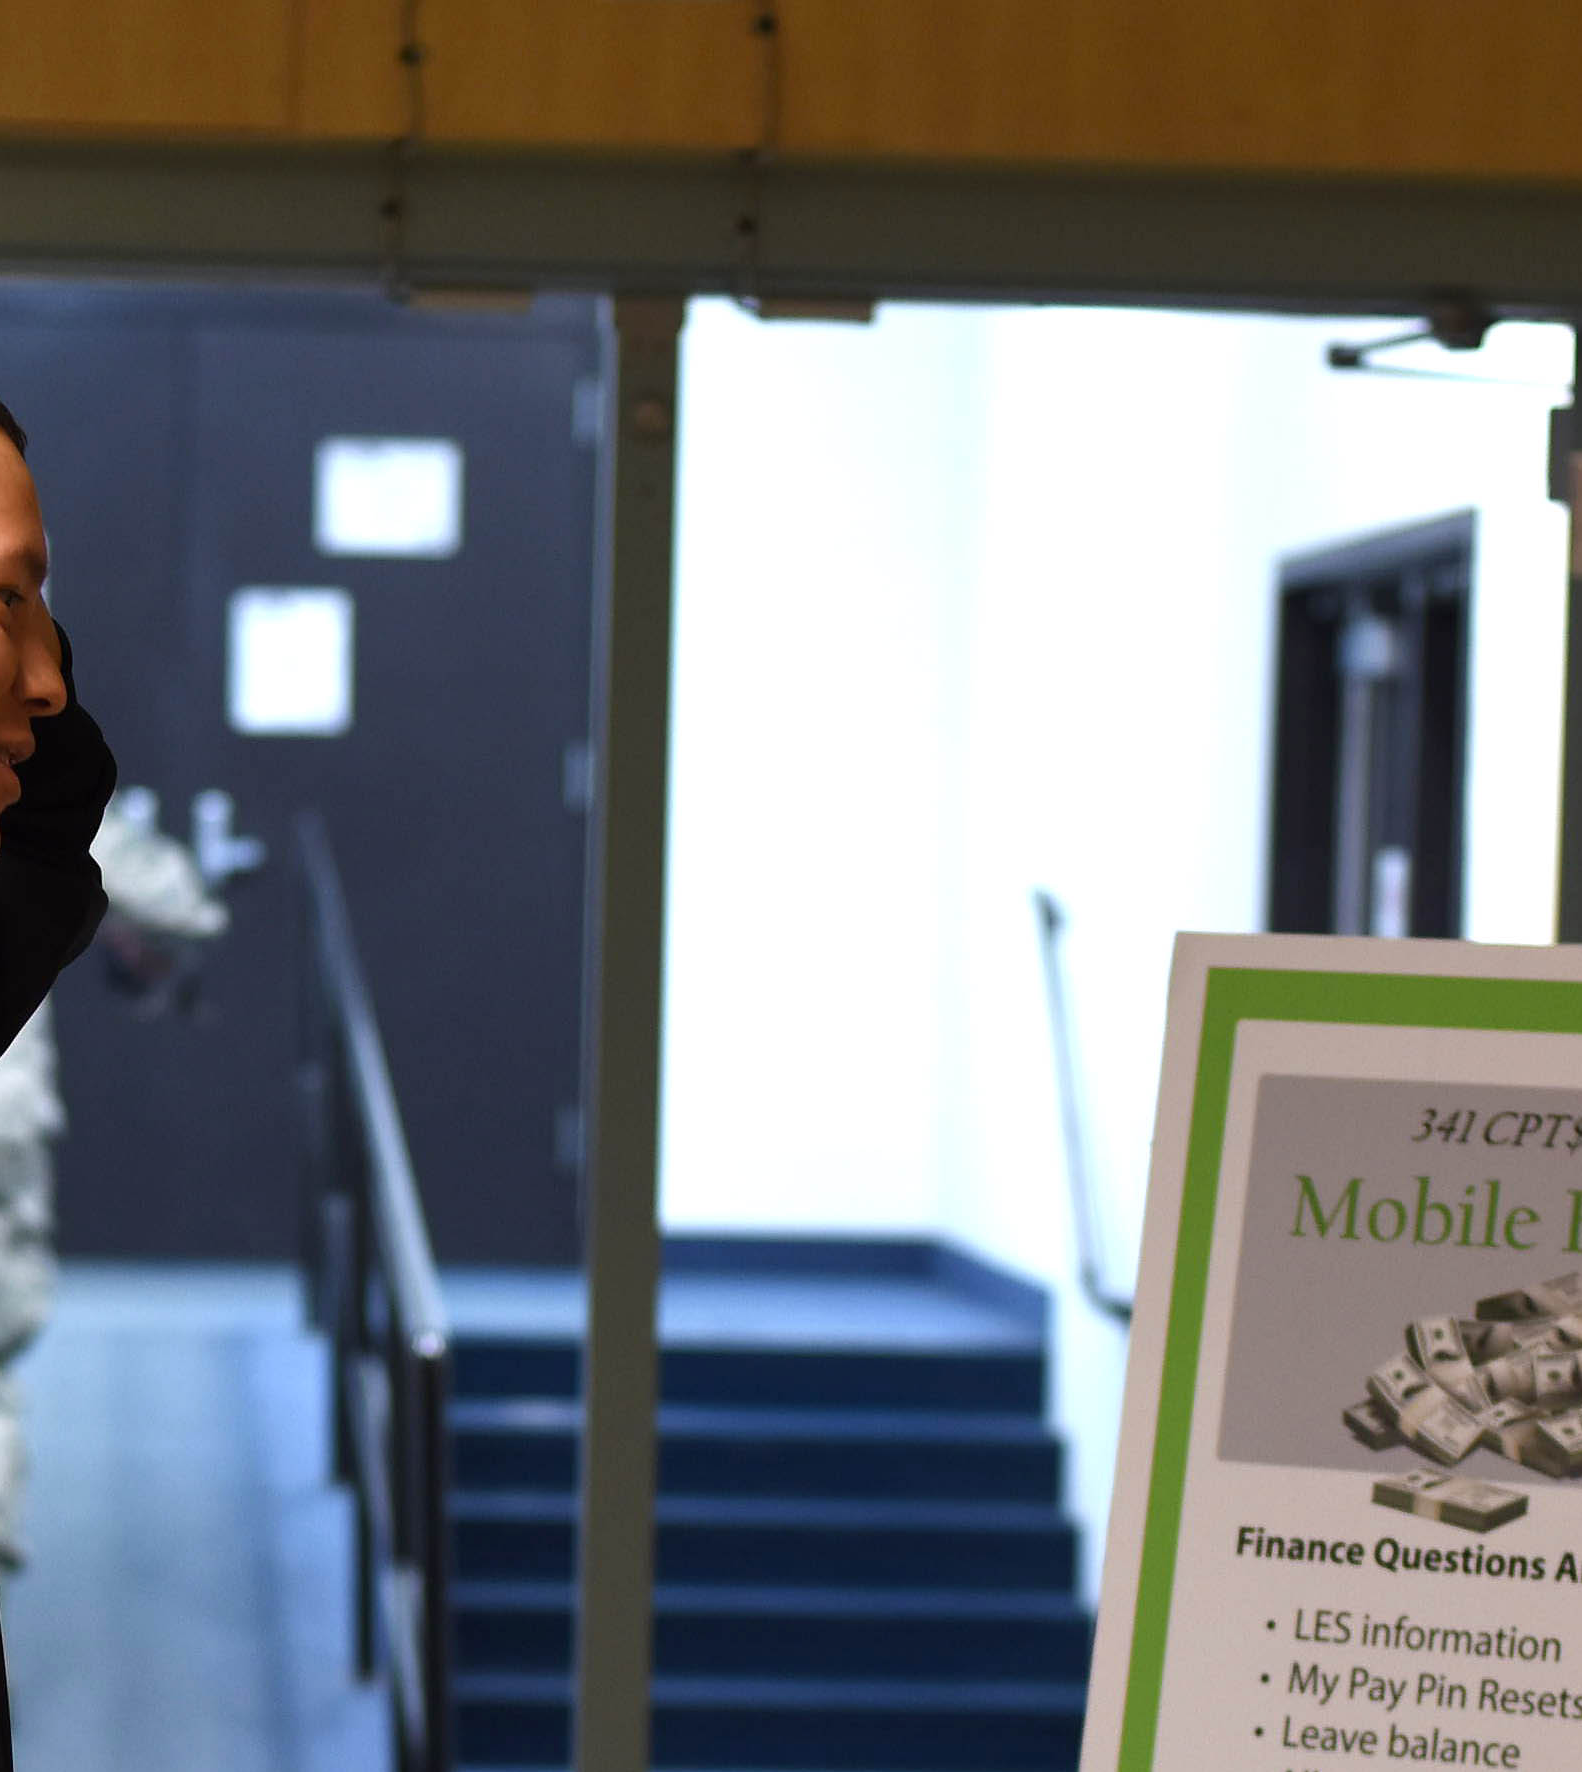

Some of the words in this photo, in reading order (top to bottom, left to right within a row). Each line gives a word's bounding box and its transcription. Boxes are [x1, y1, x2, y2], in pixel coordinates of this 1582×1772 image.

[1412, 1108, 1476, 1144] 341
[1291, 1175, 1540, 1251] Mobile
[1235, 1526, 1366, 1567] Finance
[1372, 1537, 1546, 1581] Questions
[1294, 1608, 1353, 1644] LES
[1361, 1614, 1561, 1663] information
[1288, 1661, 1340, 1706] My
[1348, 1667, 1407, 1712] Pay
[1416, 1673, 1467, 1709] Pin
[1282, 1715, 1378, 1756] Leave
[1388, 1723, 1520, 1769] balance
